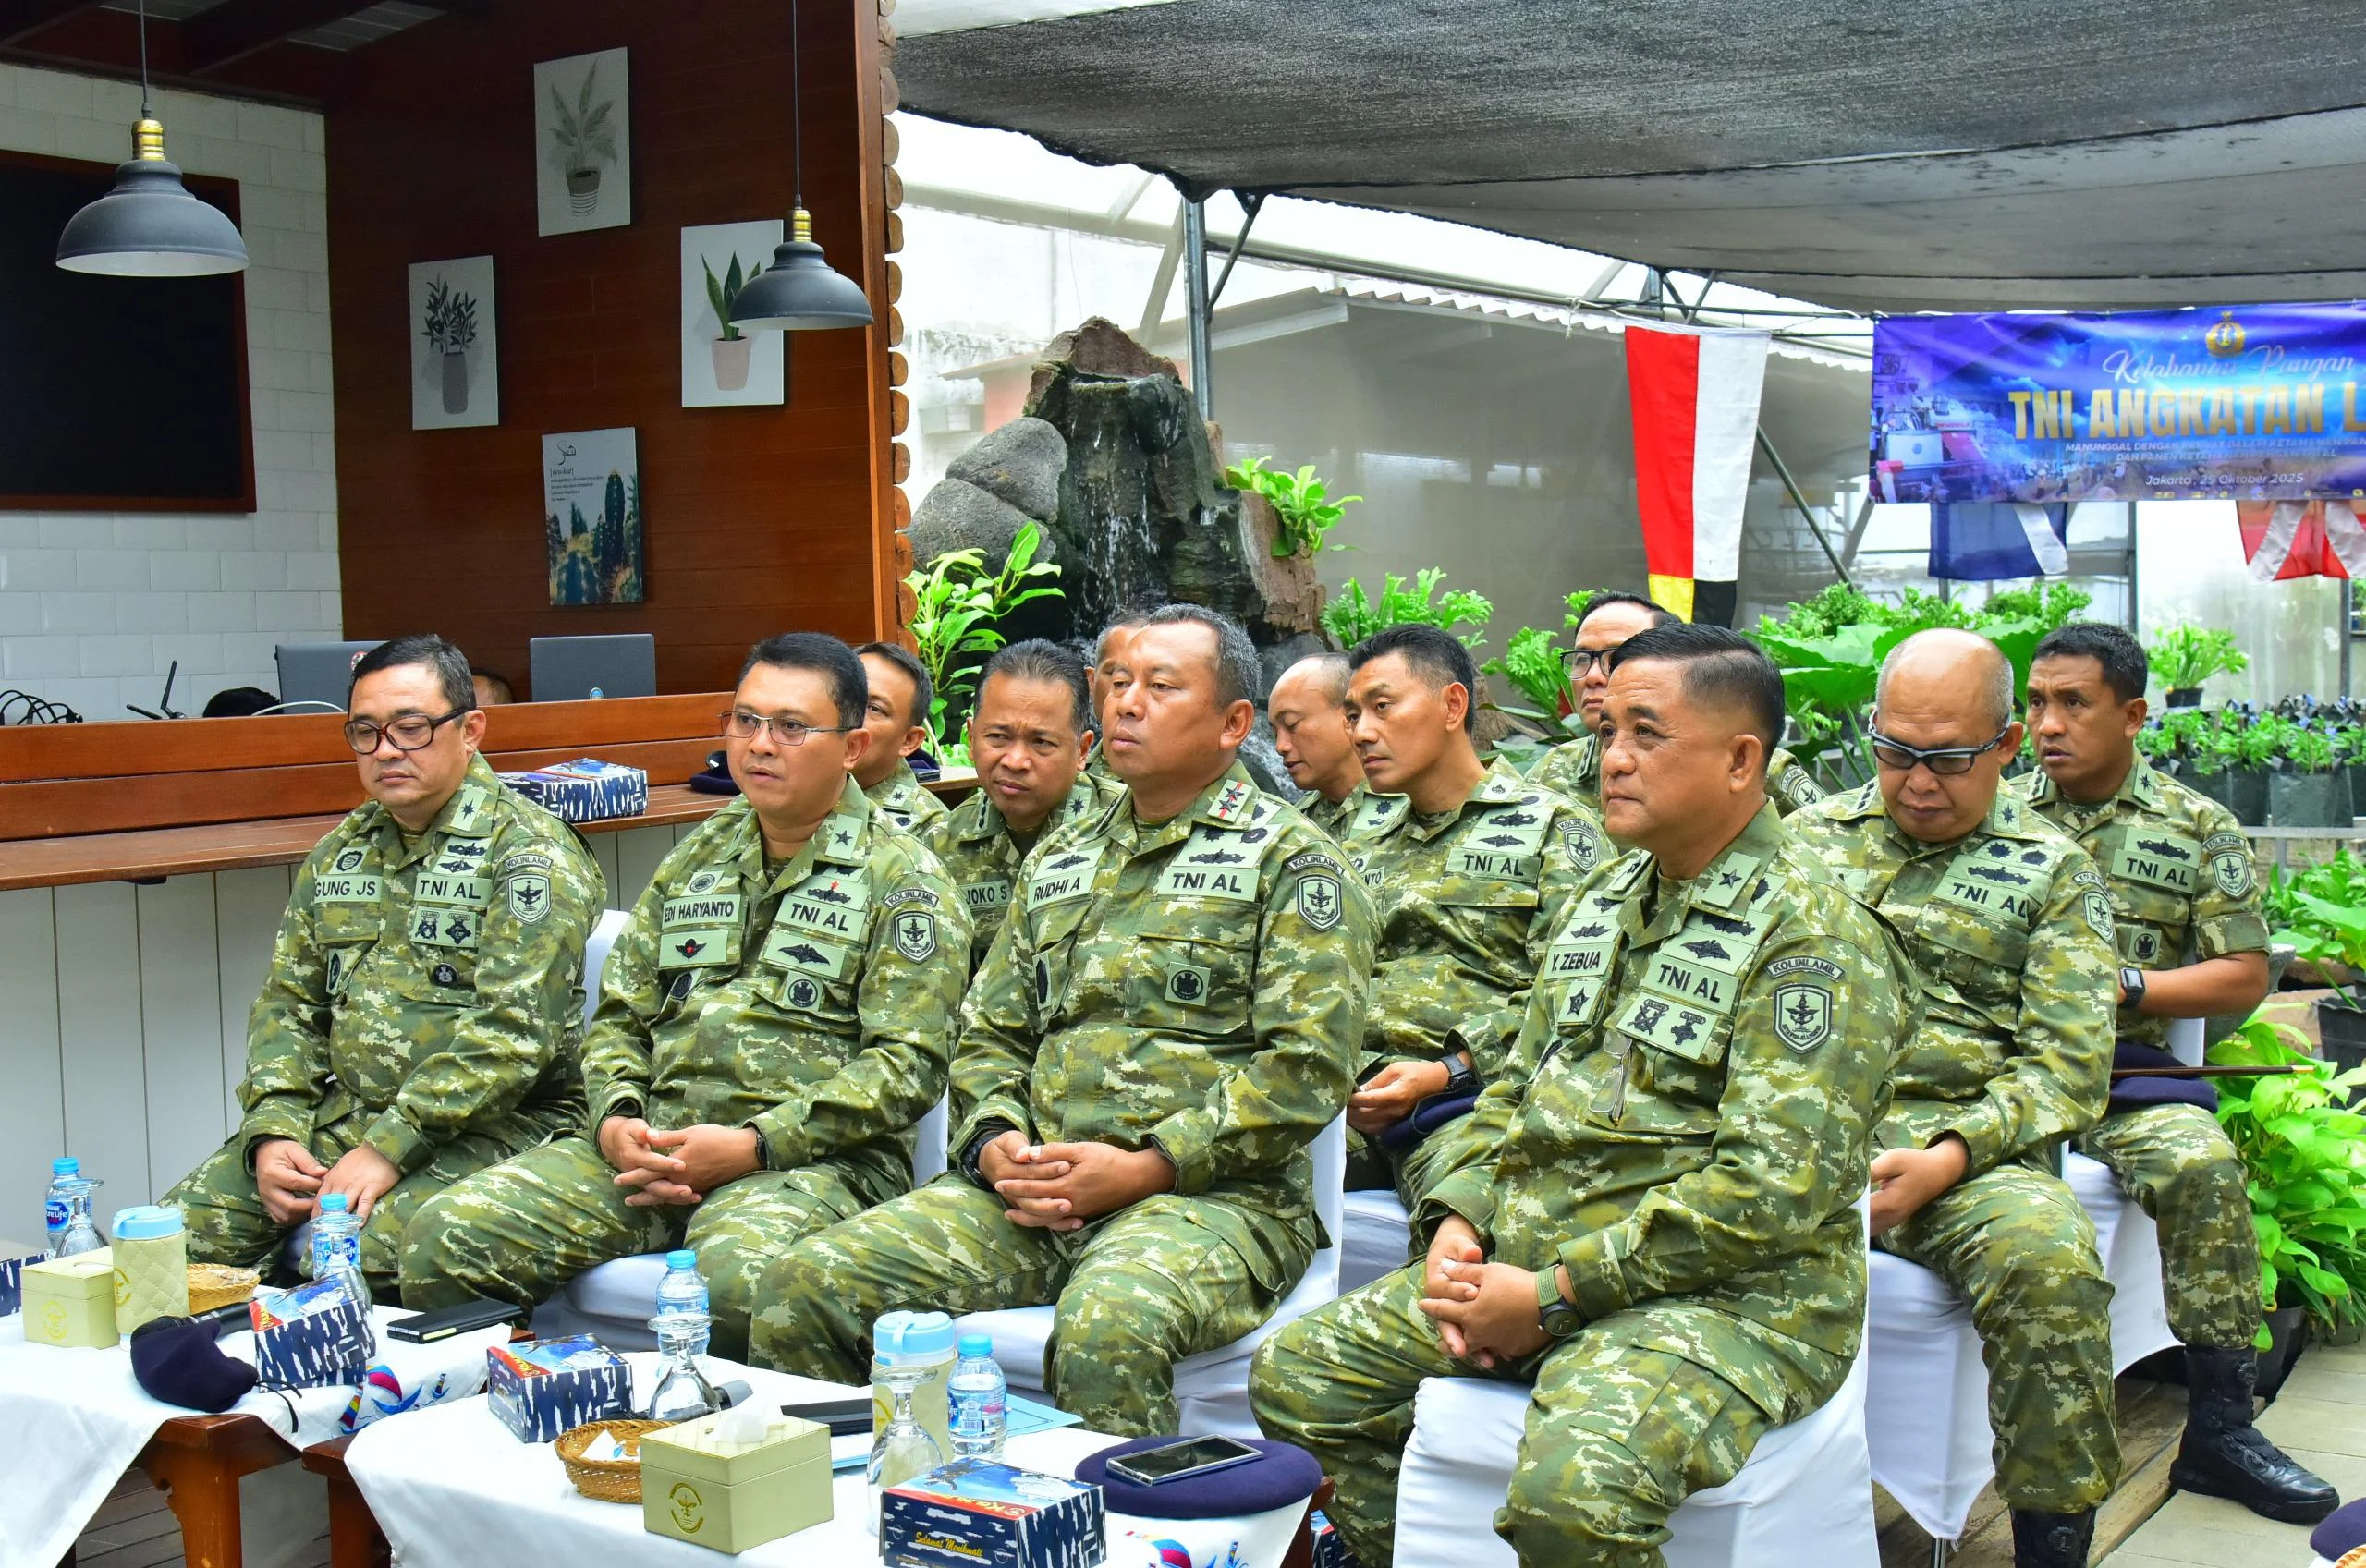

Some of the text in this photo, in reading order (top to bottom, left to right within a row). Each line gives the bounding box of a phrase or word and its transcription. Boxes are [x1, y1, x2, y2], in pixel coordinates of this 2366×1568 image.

[2007, 390, 2073, 440] TNI
[2088, 383, 2324, 438] ANGKATAN
[2065, 443, 2132, 452] MANUNGGAL
[2116, 452, 2140, 462] DAN
[2199, 474, 2215, 484] 29
[2218, 473, 2268, 485] Oktober
[2270, 472, 2305, 484] 2025
[506, 856, 549, 869] KOLINLAMIL
[1291, 855, 1339, 870] KOLINLAMIL
[1464, 855, 1524, 876] TNI AL
[2127, 857, 2188, 887] TNI AL
[356, 881, 376, 896] JS
[420, 880, 482, 900] TNI AL
[1033, 876, 1080, 903] RUDHI A
[1173, 872, 1241, 893] TNI AL
[888, 891, 933, 905] KOLINLAMIL
[965, 884, 1007, 906] JOKO S
[1952, 882, 2026, 918] TNI AL
[664, 901, 735, 923] EDI HARYANTO
[790, 903, 848, 932] TNI AL
[1559, 951, 1601, 970] ZEBUA
[1772, 957, 1835, 976] KOLINLAMIL
[1658, 963, 1721, 1003] TNI AL
[915, 1531, 983, 1557] Selamat Menikmati
